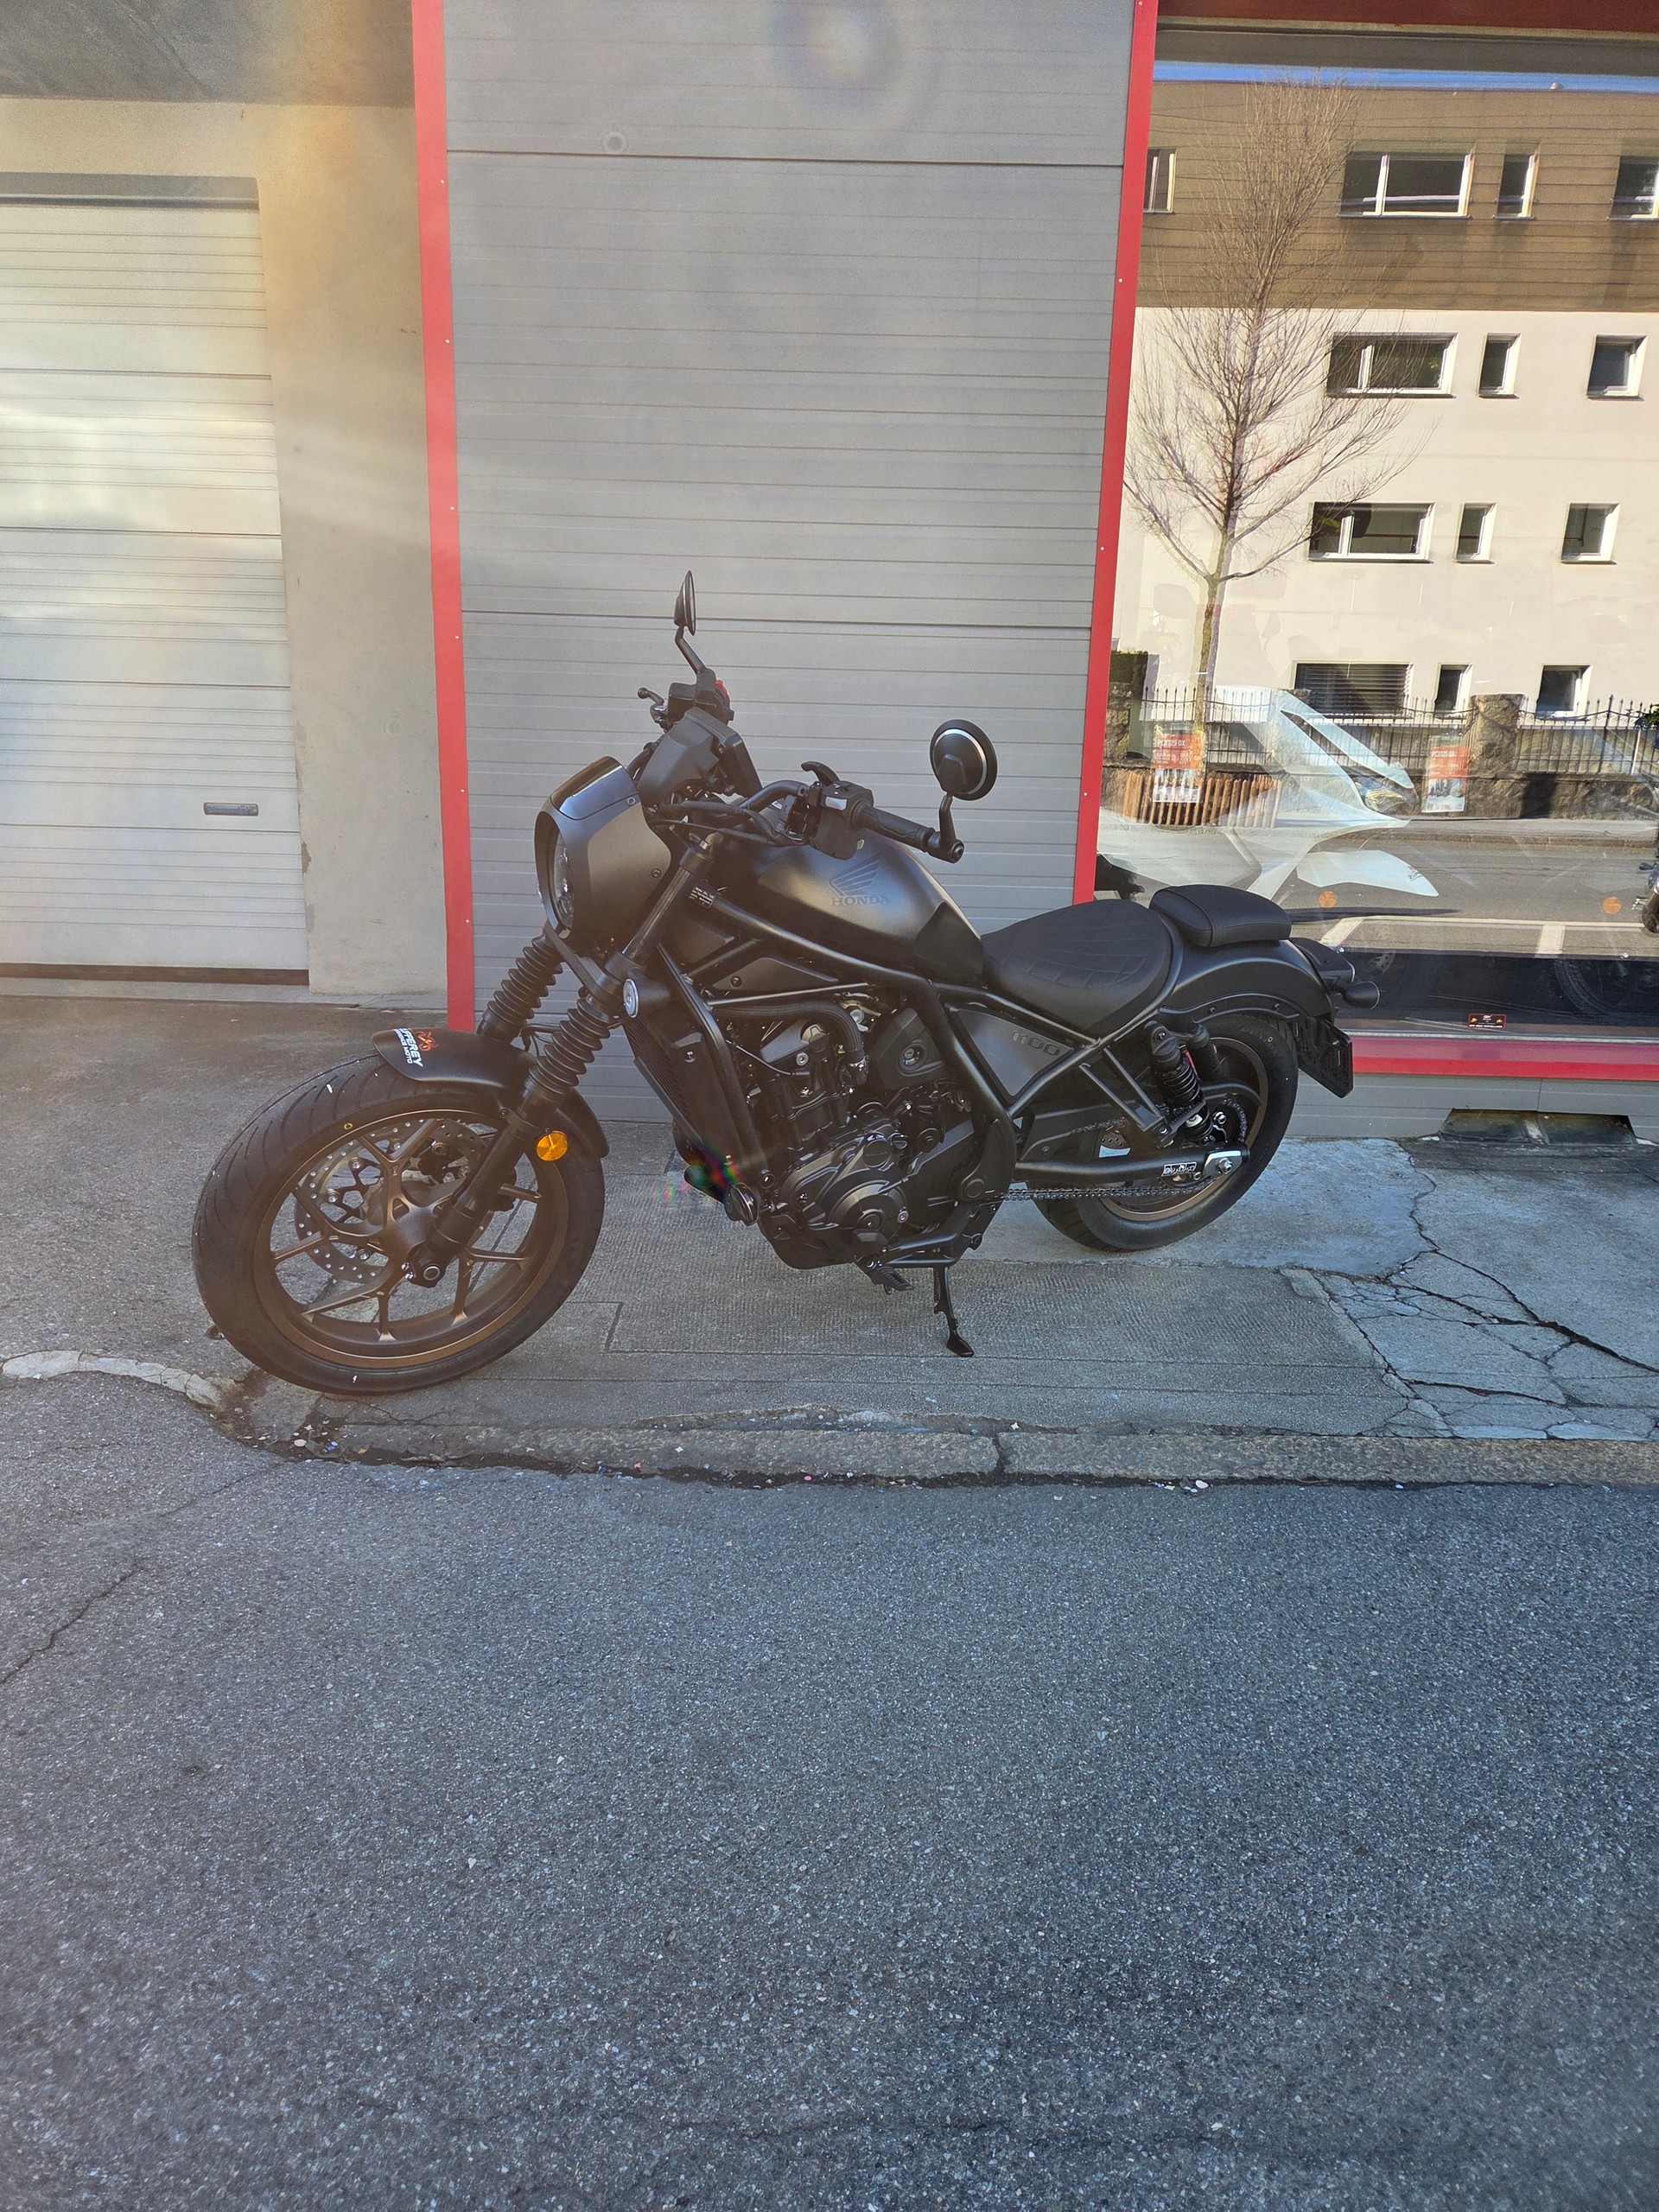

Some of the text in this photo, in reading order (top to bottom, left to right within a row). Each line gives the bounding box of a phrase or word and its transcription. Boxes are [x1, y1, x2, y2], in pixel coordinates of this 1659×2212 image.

[830, 896, 890, 906] HONDA
[1013, 1029, 1061, 1056] 1100
[403, 1046, 413, 1065] MOTO
